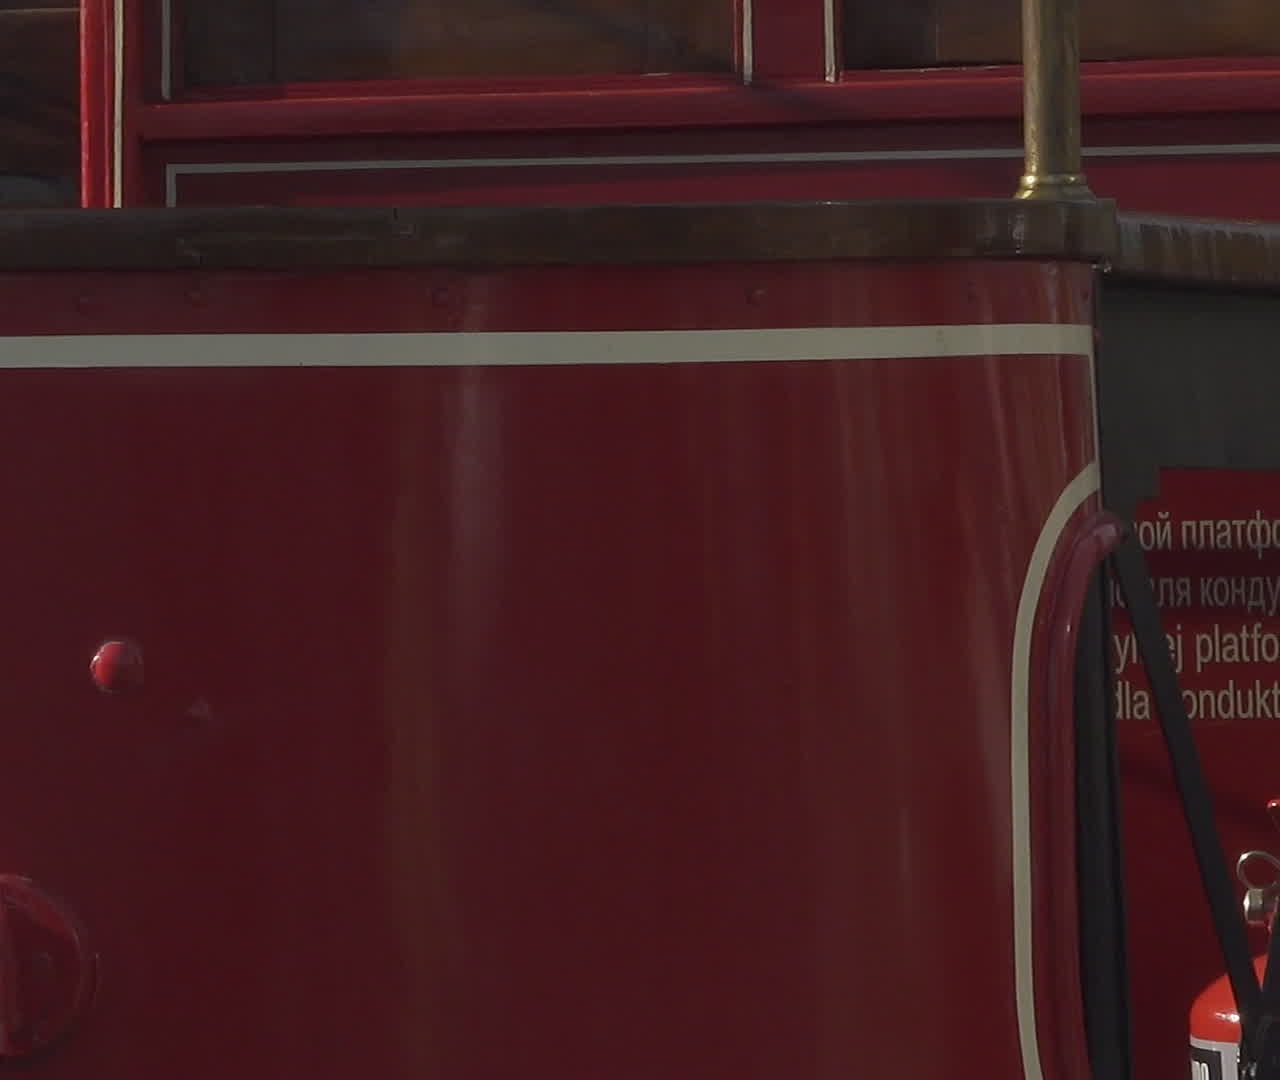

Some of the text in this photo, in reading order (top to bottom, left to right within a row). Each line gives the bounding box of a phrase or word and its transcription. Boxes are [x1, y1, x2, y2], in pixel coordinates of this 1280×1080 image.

[1133, 511, 1172, 551] ой
[1150, 576, 1192, 607] ля
[1195, 623, 1280, 673] platfo
[1182, 679, 1280, 719] ondukt
